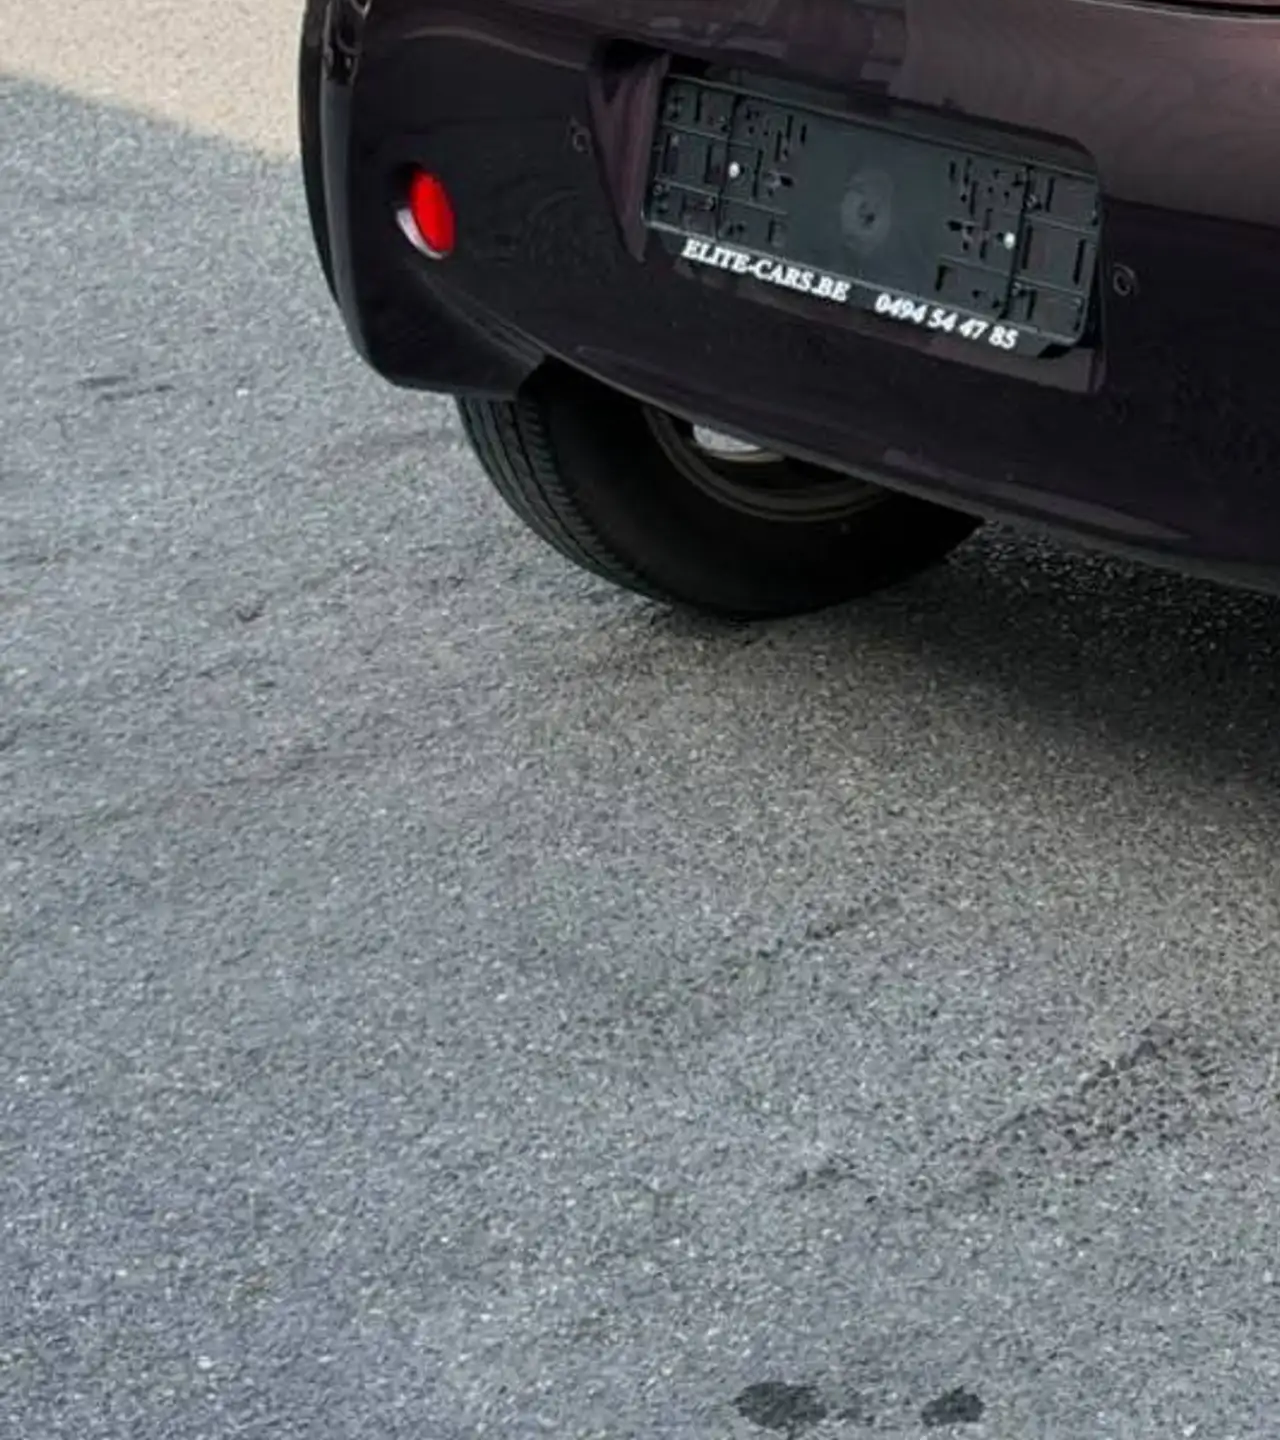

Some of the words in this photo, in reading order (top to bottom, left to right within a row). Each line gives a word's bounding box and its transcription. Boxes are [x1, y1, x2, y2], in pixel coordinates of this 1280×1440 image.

[681, 237, 851, 302] ELITE-CARS.BE
[875, 292, 928, 324] 0494
[927, 307, 958, 333] 54
[959, 317, 989, 340] 47
[988, 324, 1019, 349] 85
